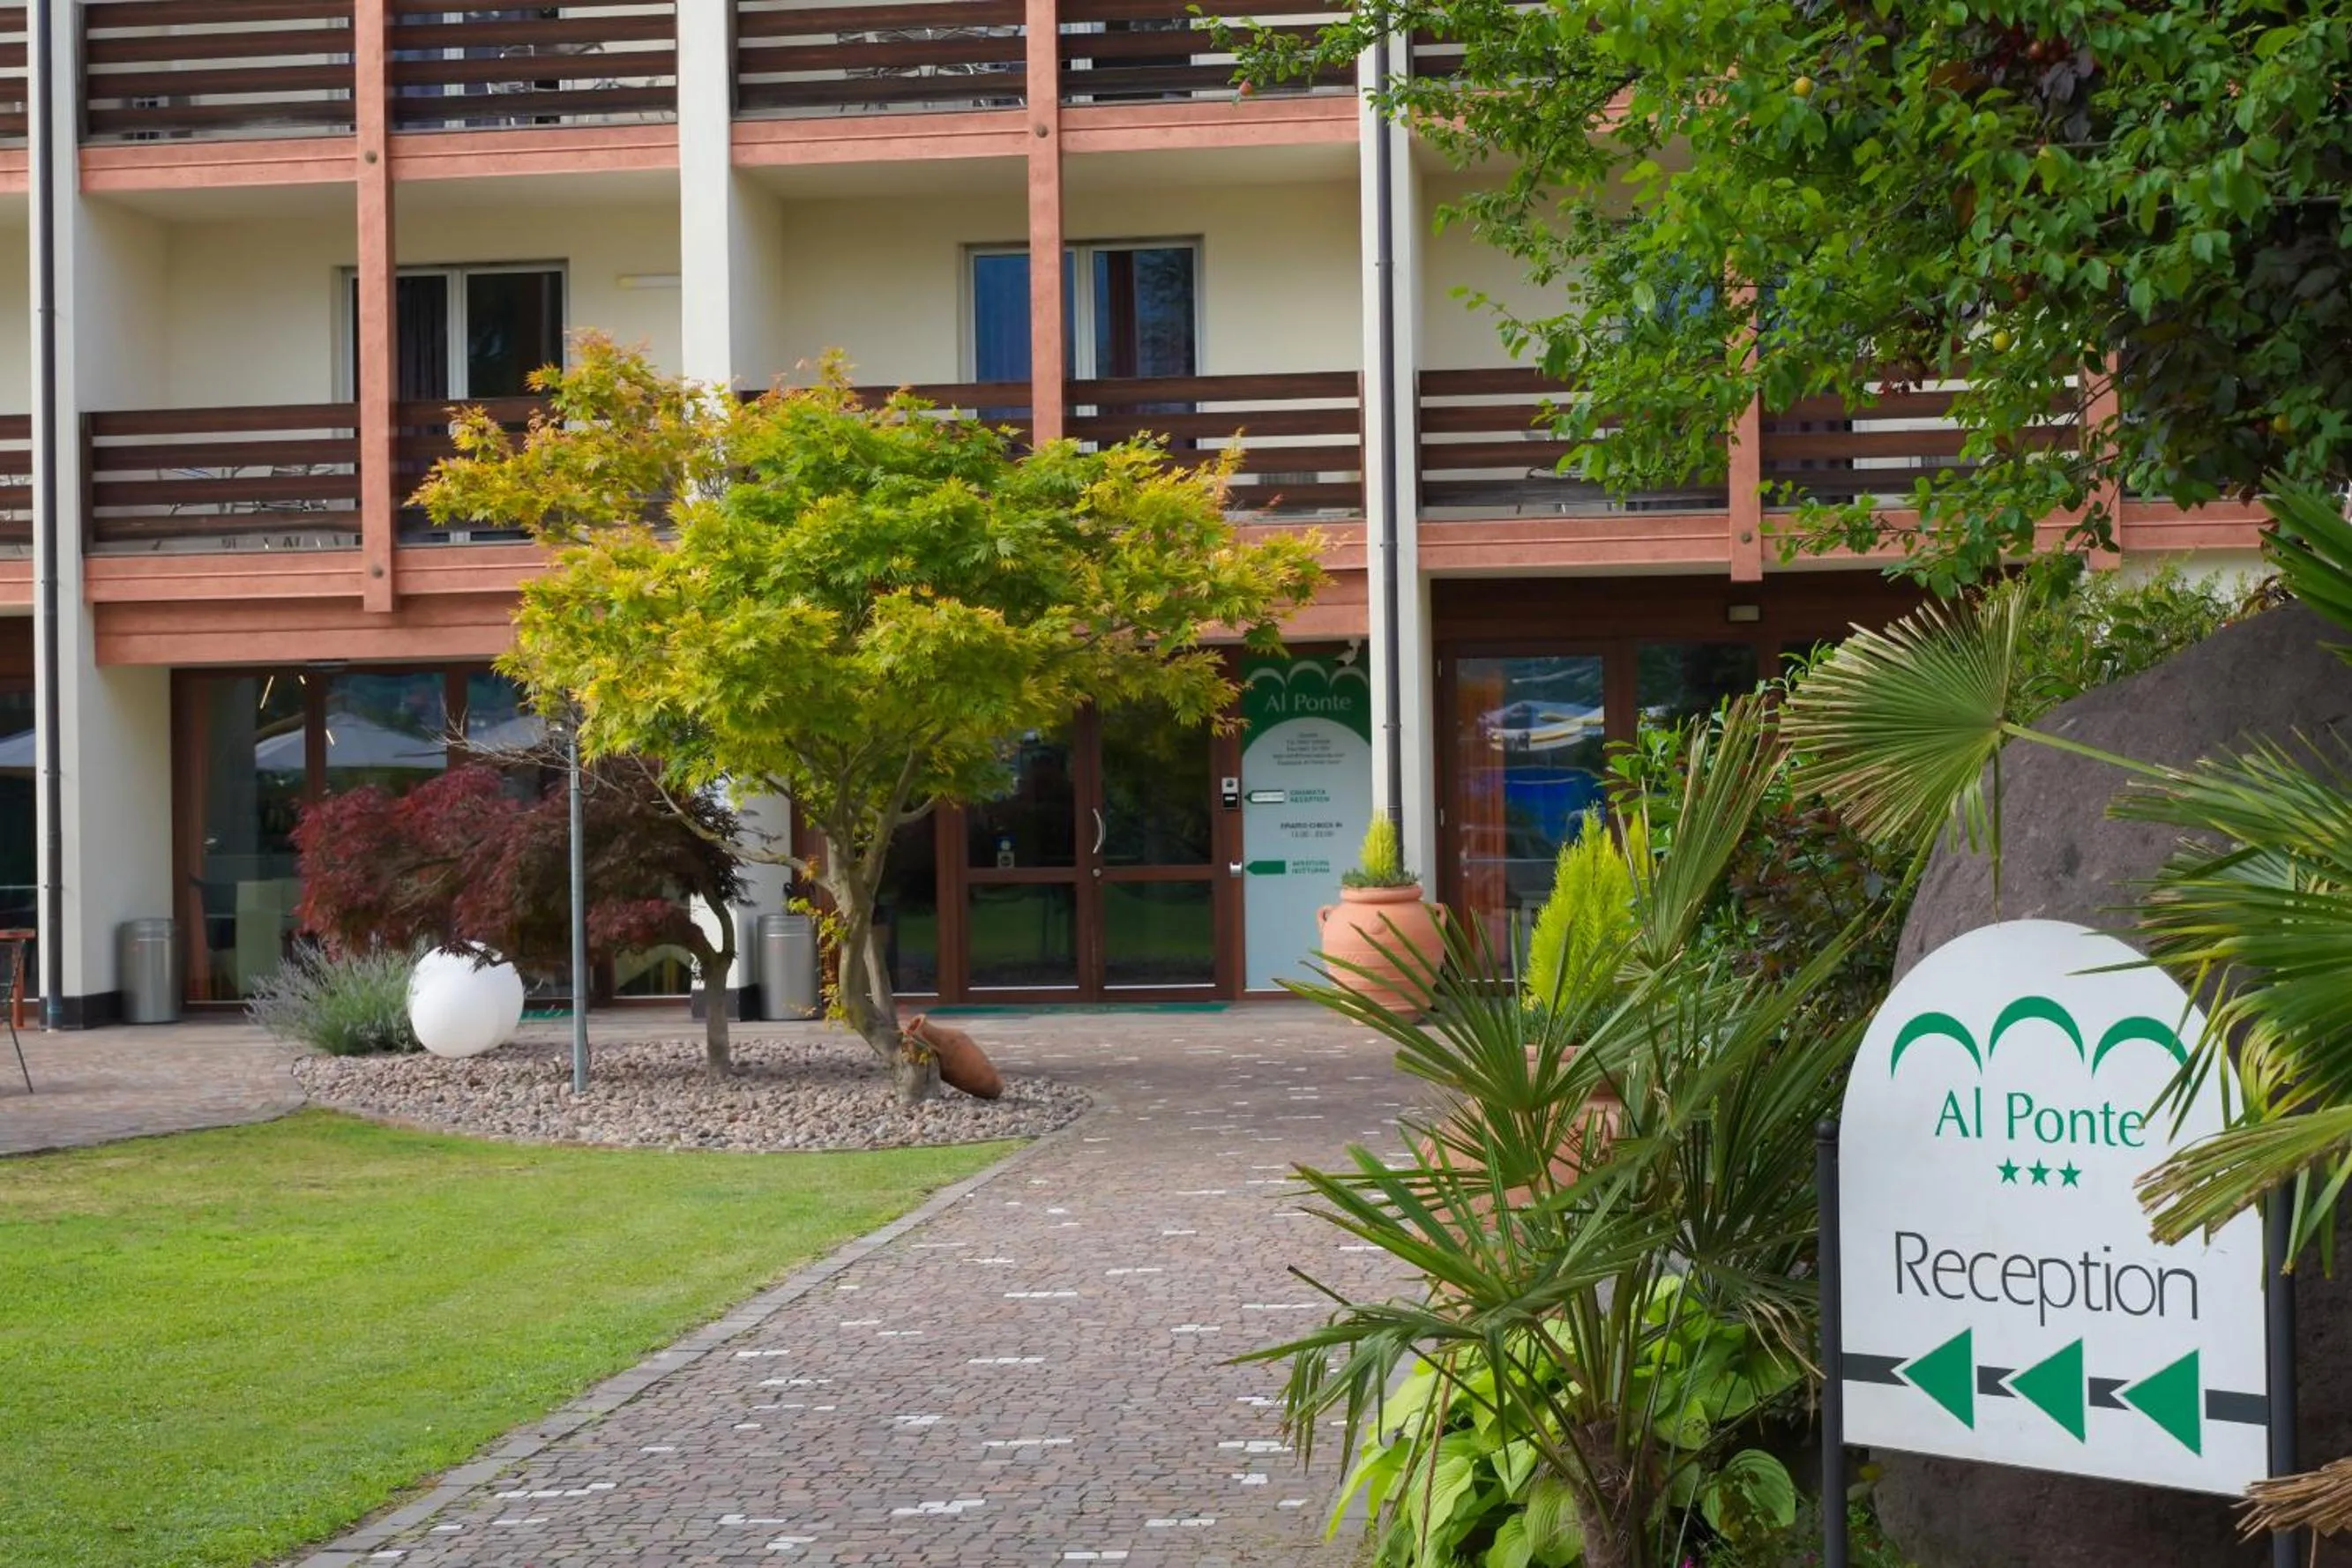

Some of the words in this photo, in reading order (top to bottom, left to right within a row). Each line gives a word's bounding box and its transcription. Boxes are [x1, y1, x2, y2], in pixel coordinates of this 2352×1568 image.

[1264, 692, 1287, 713] Al
[1294, 692, 1353, 712] Ponte
[1934, 1086, 1982, 1139] Al
[2006, 1091, 2146, 1147] Ponte
[1894, 1230, 2199, 1326] Reception
